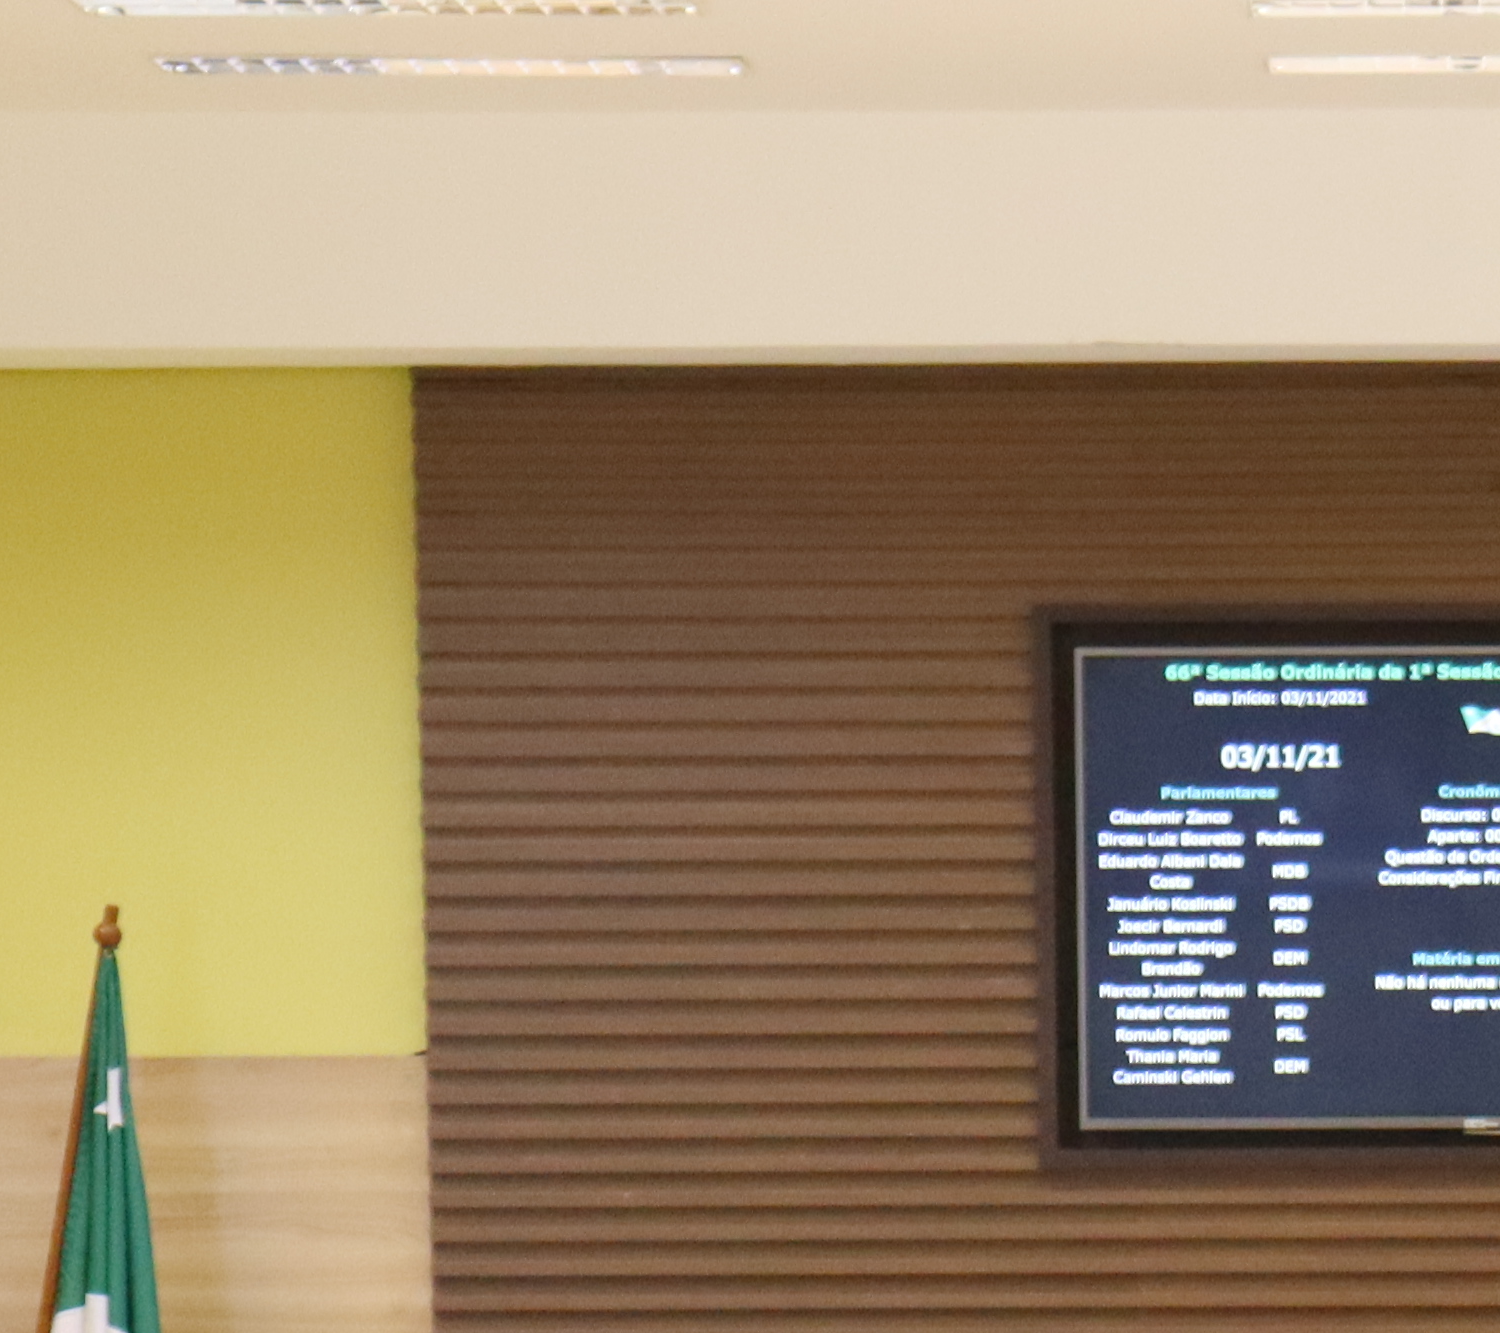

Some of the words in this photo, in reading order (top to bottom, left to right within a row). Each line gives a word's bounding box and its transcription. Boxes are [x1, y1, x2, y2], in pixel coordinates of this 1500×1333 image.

[1206, 662, 1278, 682] Sessão
[1280, 662, 1376, 682] Ordinária
[1378, 663, 1406, 681] da
[1409, 662, 1434, 681] 1ª
[1193, 689, 1231, 707] Data
[1232, 689, 1278, 707] Início:
[1280, 689, 1368, 707] 03/11/2021
[1220, 743, 1342, 772] 03/11/21
[1160, 785, 1279, 800] Parlamentares
[1110, 808, 1184, 826] Claudemir
[1185, 808, 1233, 826] Zanco
[1279, 807, 1300, 825] PL
[1420, 806, 1489, 823] Discurso:
[1098, 830, 1146, 847] Dirceu
[1147, 830, 1179, 847] Luiz
[1180, 830, 1245, 847] Boaretto
[1256, 830, 1324, 847] Podemos
[1427, 826, 1482, 846] Aparte:
[1098, 853, 1160, 869] Eduardo
[1161, 852, 1208, 869] Albani
[1208, 853, 1245, 869] Dala
[1384, 847, 1446, 867] Questão
[1446, 849, 1468, 865] de
[1271, 861, 1310, 879] MDB
[1378, 867, 1482, 888] Considerações
[1149, 873, 1194, 890] Costa
[1107, 895, 1170, 912] Januário
[1171, 895, 1237, 912] Koslinski
[1268, 894, 1312, 911] PSDB
[1117, 917, 1161, 934] Joecir
[1162, 917, 1227, 934] Bernardi
[1274, 916, 1308, 934] PSD
[1108, 939, 1176, 956] Lindomar
[1178, 939, 1237, 958] Rodrigo
[1272, 948, 1309, 966] DEM
[1412, 950, 1474, 966] Matéria
[1141, 959, 1205, 977] Brandão
[1099, 981, 1151, 998] Marcos
[1152, 981, 1198, 998] Junior
[1199, 981, 1247, 998] Marini
[1257, 981, 1325, 998] Podemos
[1374, 973, 1405, 990] Não
[1406, 973, 1428, 990] há
[1429, 974, 1498, 990] nenhuma
[1116, 1004, 1162, 1020] Rafael
[1163, 1004, 1230, 1020] Celestrin
[1274, 1002, 1308, 1020] PSD
[1430, 996, 1452, 1011] ou
[1452, 996, 1489, 1013] para
[1115, 1026, 1171, 1042] Romulo
[1172, 1026, 1231, 1045] Faggion
[1276, 1024, 1307, 1042] PSL
[1125, 1048, 1177, 1064] Thania
[1177, 1048, 1220, 1064] Maria
[1273, 1056, 1310, 1074] DEM
[1113, 1069, 1180, 1085] Caminski
[1181, 1069, 1235, 1085] Gehlen
